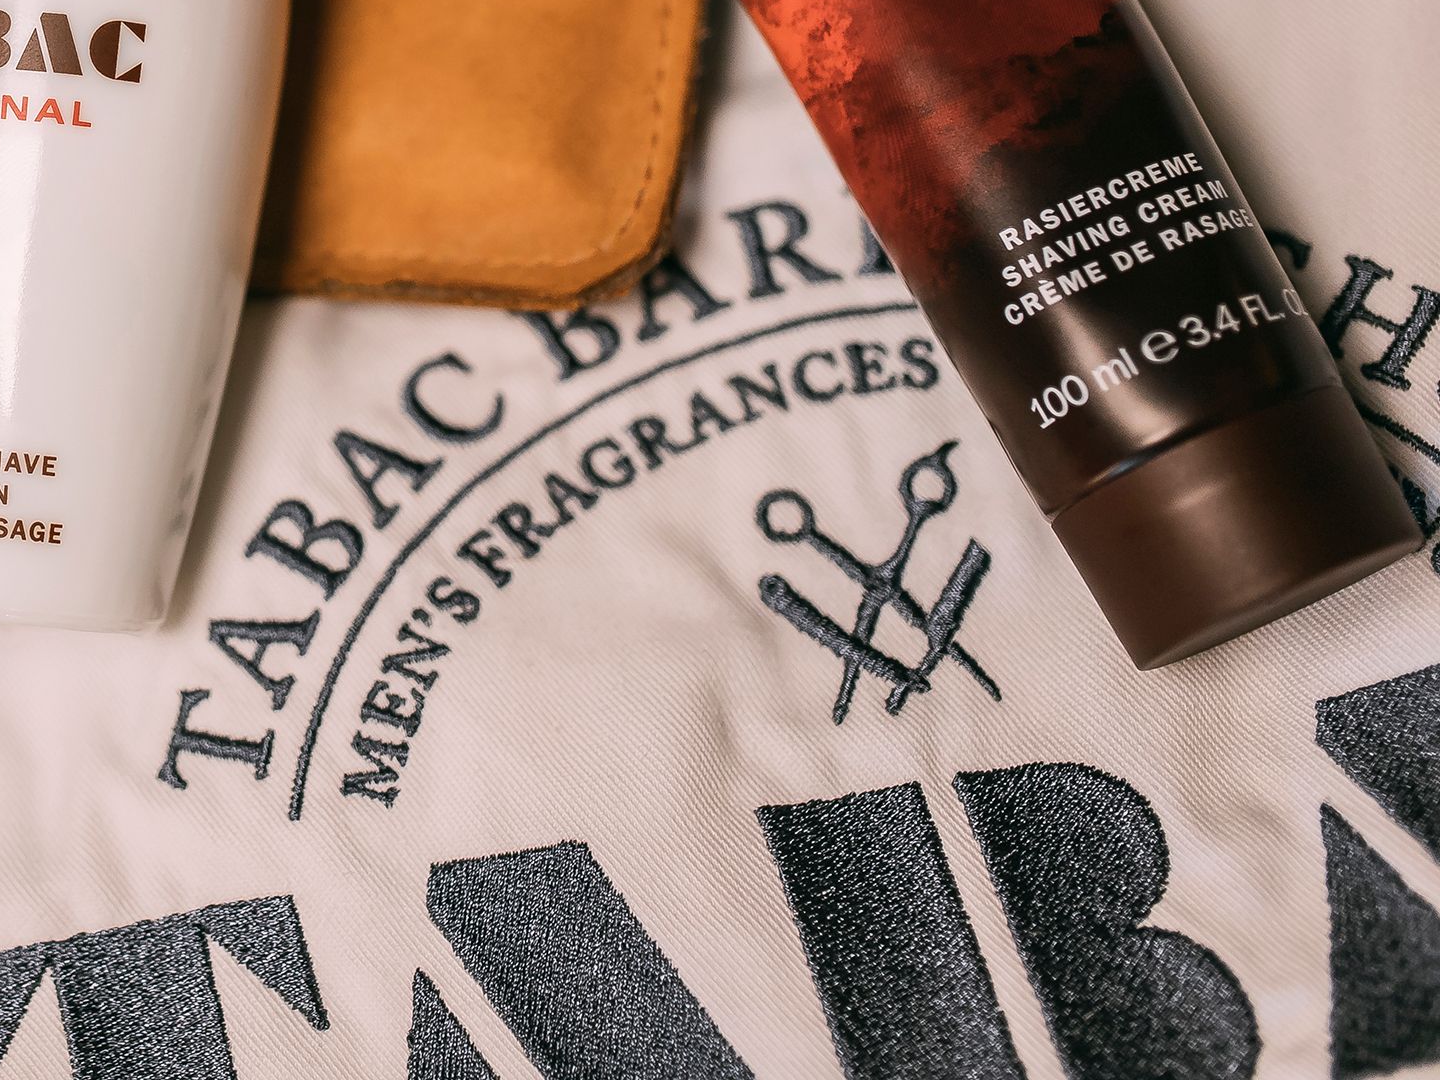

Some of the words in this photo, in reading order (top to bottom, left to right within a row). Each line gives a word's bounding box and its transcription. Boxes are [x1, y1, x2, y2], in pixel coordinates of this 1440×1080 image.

[998, 152, 1203, 251] RASIERCREME
[1001, 215, 1130, 288] SHAVING
[1138, 179, 1229, 224] CREAM
[1004, 261, 1107, 325] CRÈME
[1110, 240, 1155, 272] DE
[1158, 208, 1254, 251] RASAGE
[1030, 374, 1090, 429] 100
[1091, 347, 1140, 392] ml
[1178, 302, 1240, 348] 3.4
[1238, 294, 1286, 326] FL.
[156, 352, 506, 790] TABAC
[340, 576, 481, 810] MEN'S
[458, 337, 940, 589] FRAGRANCES
